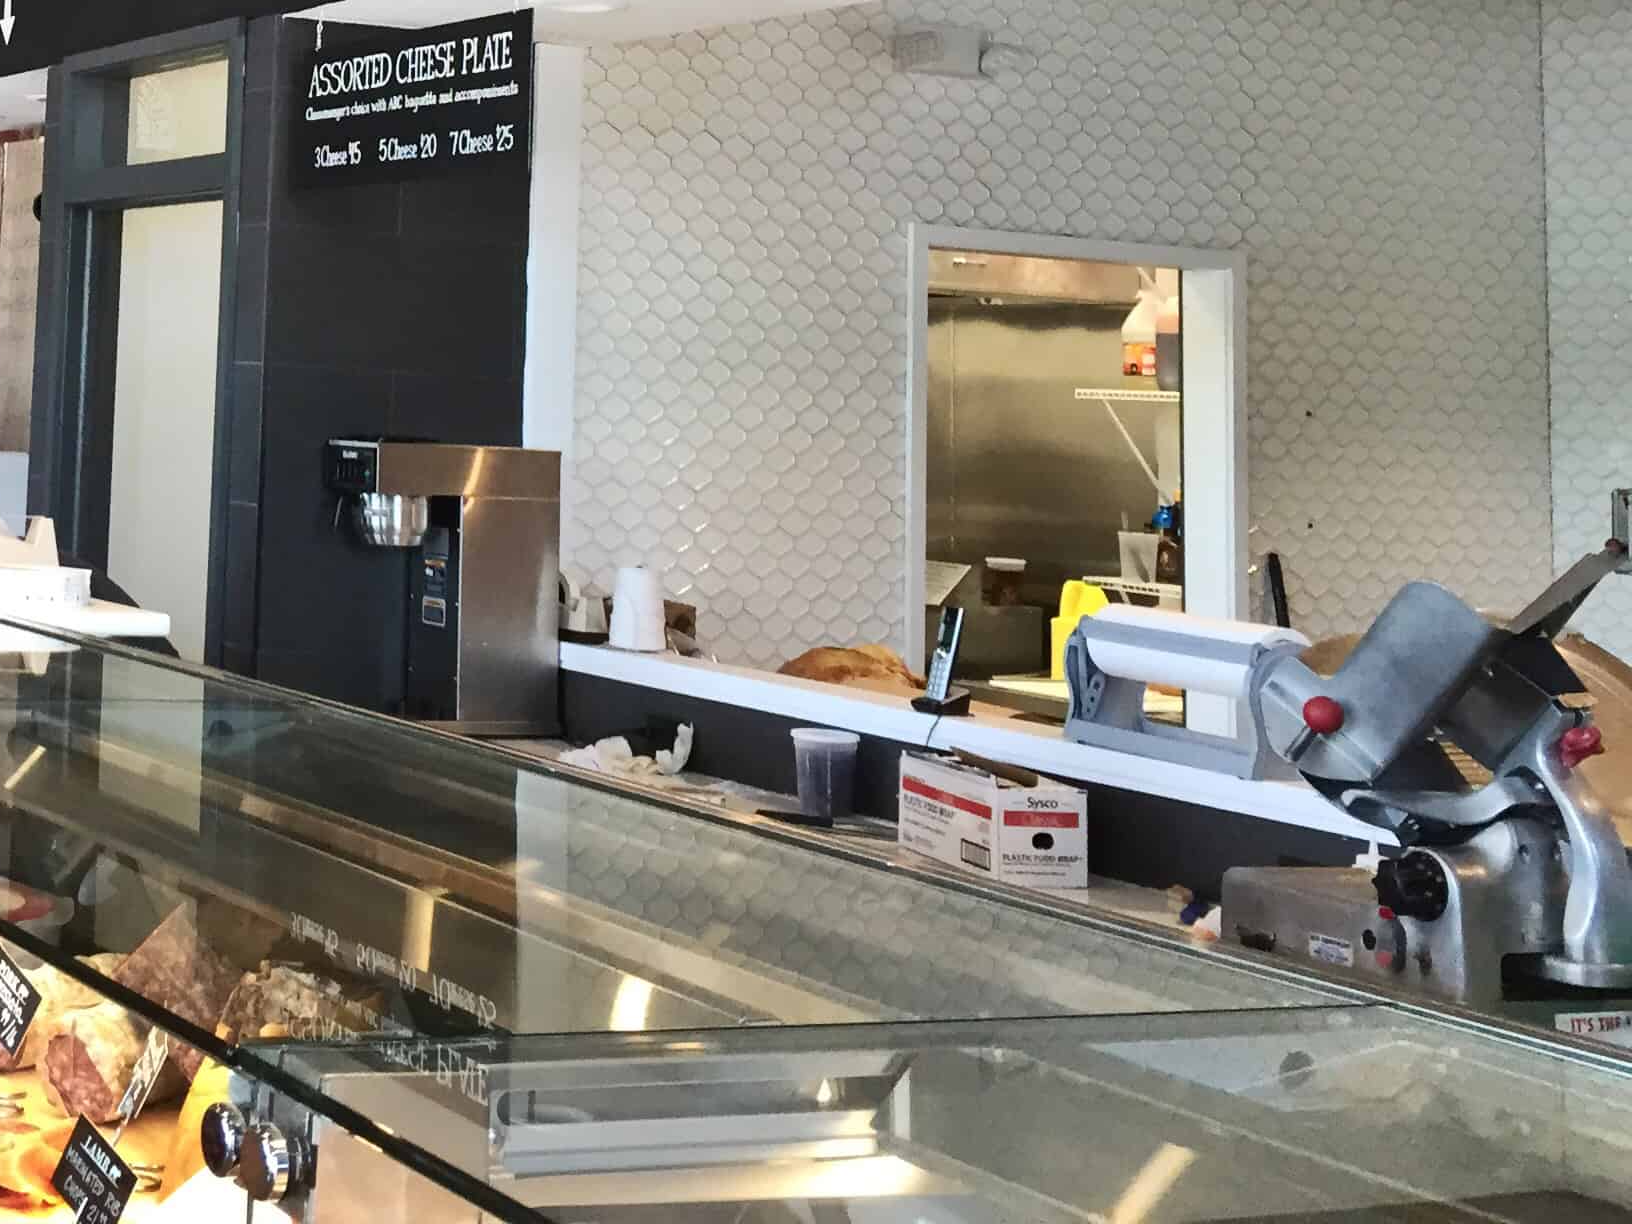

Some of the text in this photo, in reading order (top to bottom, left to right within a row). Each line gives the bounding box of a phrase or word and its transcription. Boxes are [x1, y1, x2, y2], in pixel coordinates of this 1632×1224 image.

[308, 31, 513, 98] ASSORTED CHEESE PLATE
[1026, 796, 1059, 809] Sysco
[1571, 1017, 1594, 1033] IT'S
